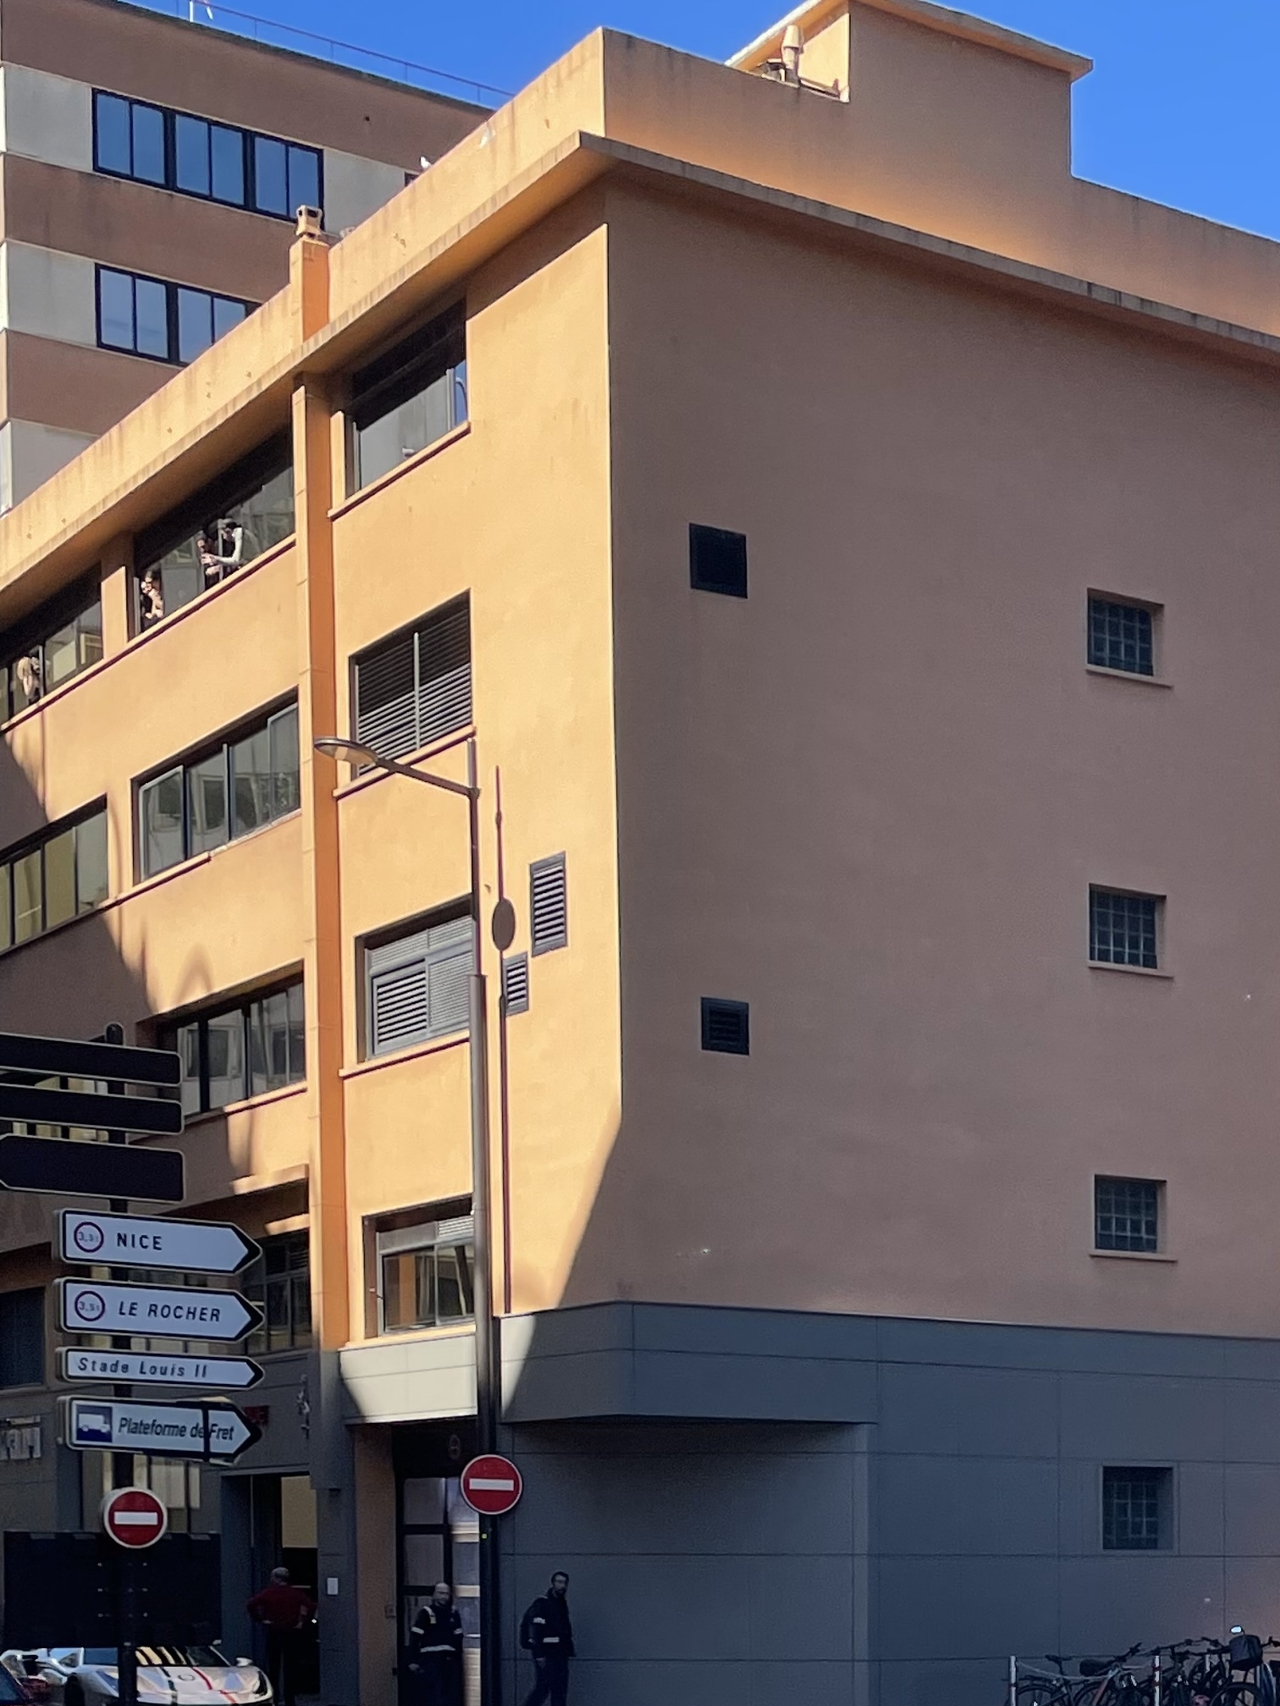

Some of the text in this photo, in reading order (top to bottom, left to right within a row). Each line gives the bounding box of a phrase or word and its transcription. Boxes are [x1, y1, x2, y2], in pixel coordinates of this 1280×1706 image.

[117, 1233, 162, 1250] NICE
[119, 1301, 221, 1322] LE ROCHER
[78, 1357, 129, 1374] Stade
[139, 1361, 185, 1377] Louis
[118, 1417, 234, 1441] Plateforme de Fret
